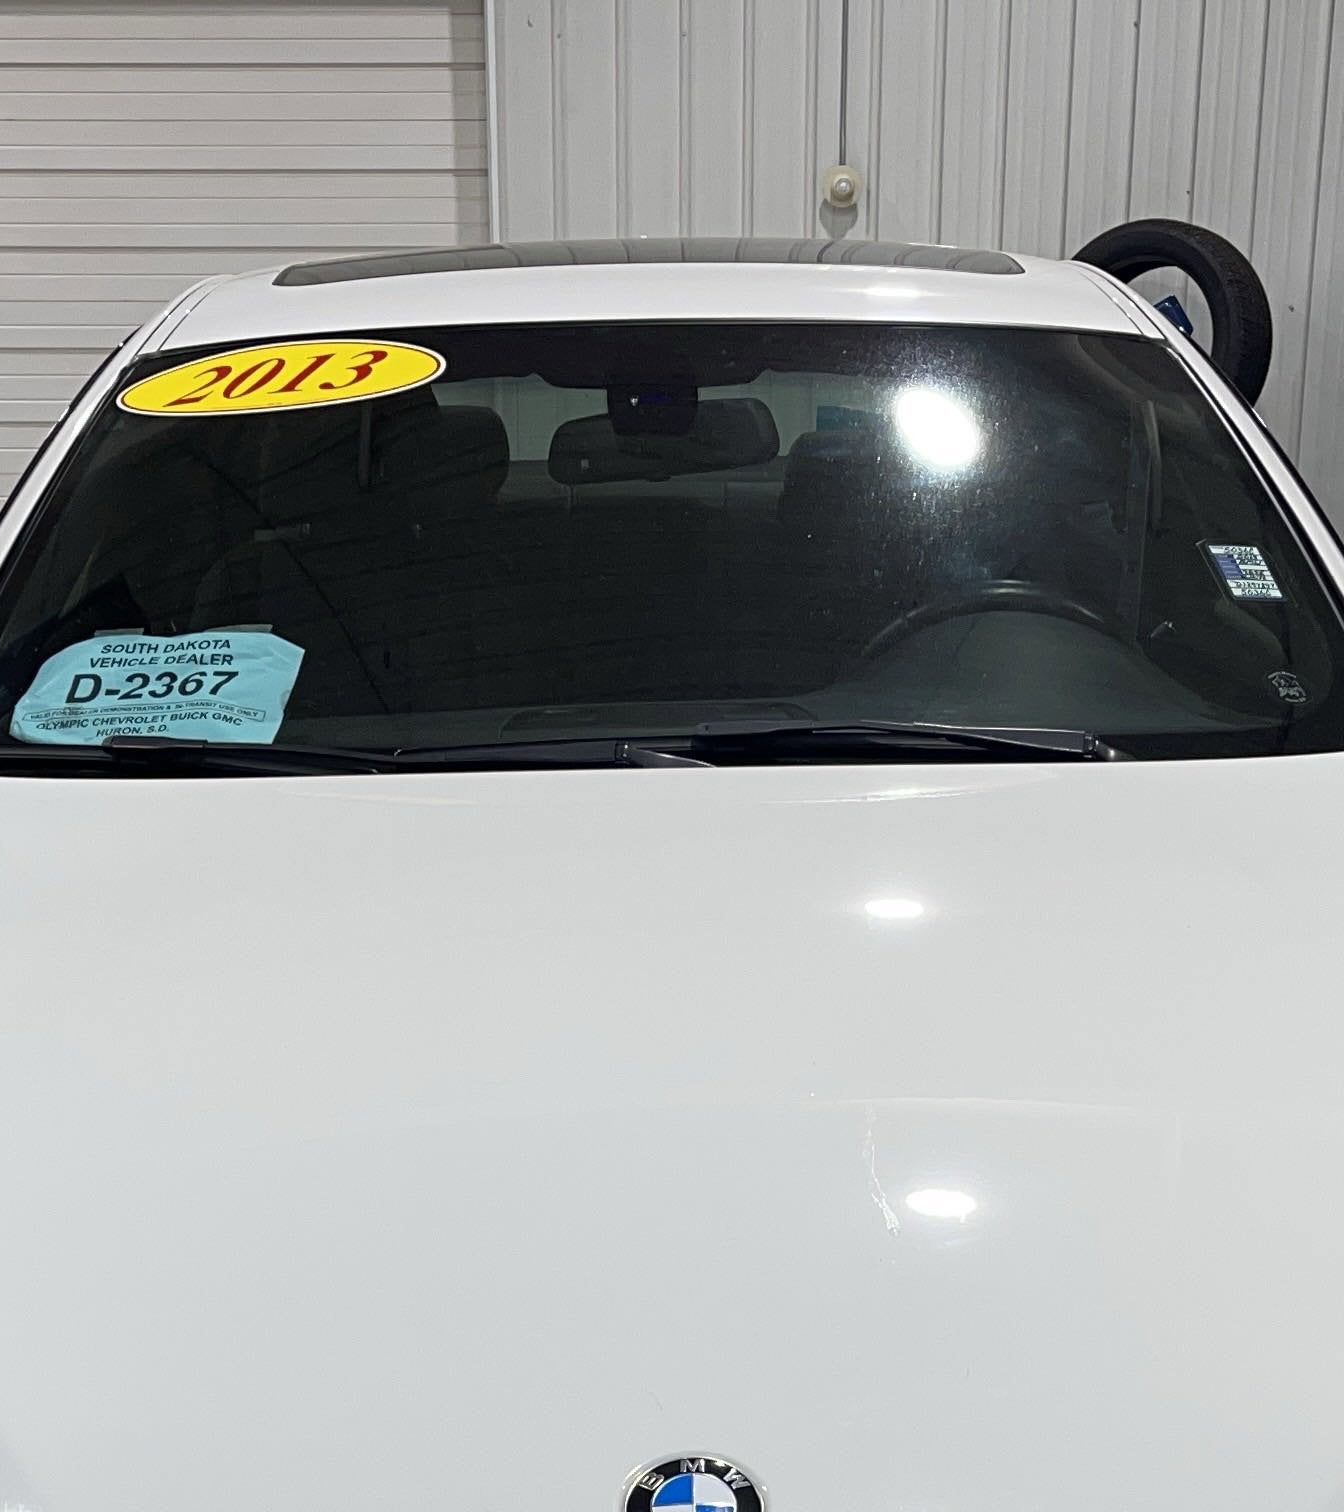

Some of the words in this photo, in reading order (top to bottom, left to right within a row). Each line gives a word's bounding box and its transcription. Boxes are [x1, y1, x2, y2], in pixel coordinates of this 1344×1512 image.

[162, 350, 388, 407] 2013
[101, 642, 158, 654] SOUTH
[163, 639, 231, 653] DAKOTA
[89, 656, 158, 668] VEHICLE
[164, 653, 234, 666] DEALER
[65, 671, 238, 704] D-2367
[36, 719, 89, 730] OLYMPIC
[92, 714, 168, 726] CHEVROLET
[170, 711, 209, 721] BUICK
[212, 712, 243, 726] GMC
[236, 708, 258, 717] ONLY
[638, 1459, 751, 1490] BMW
